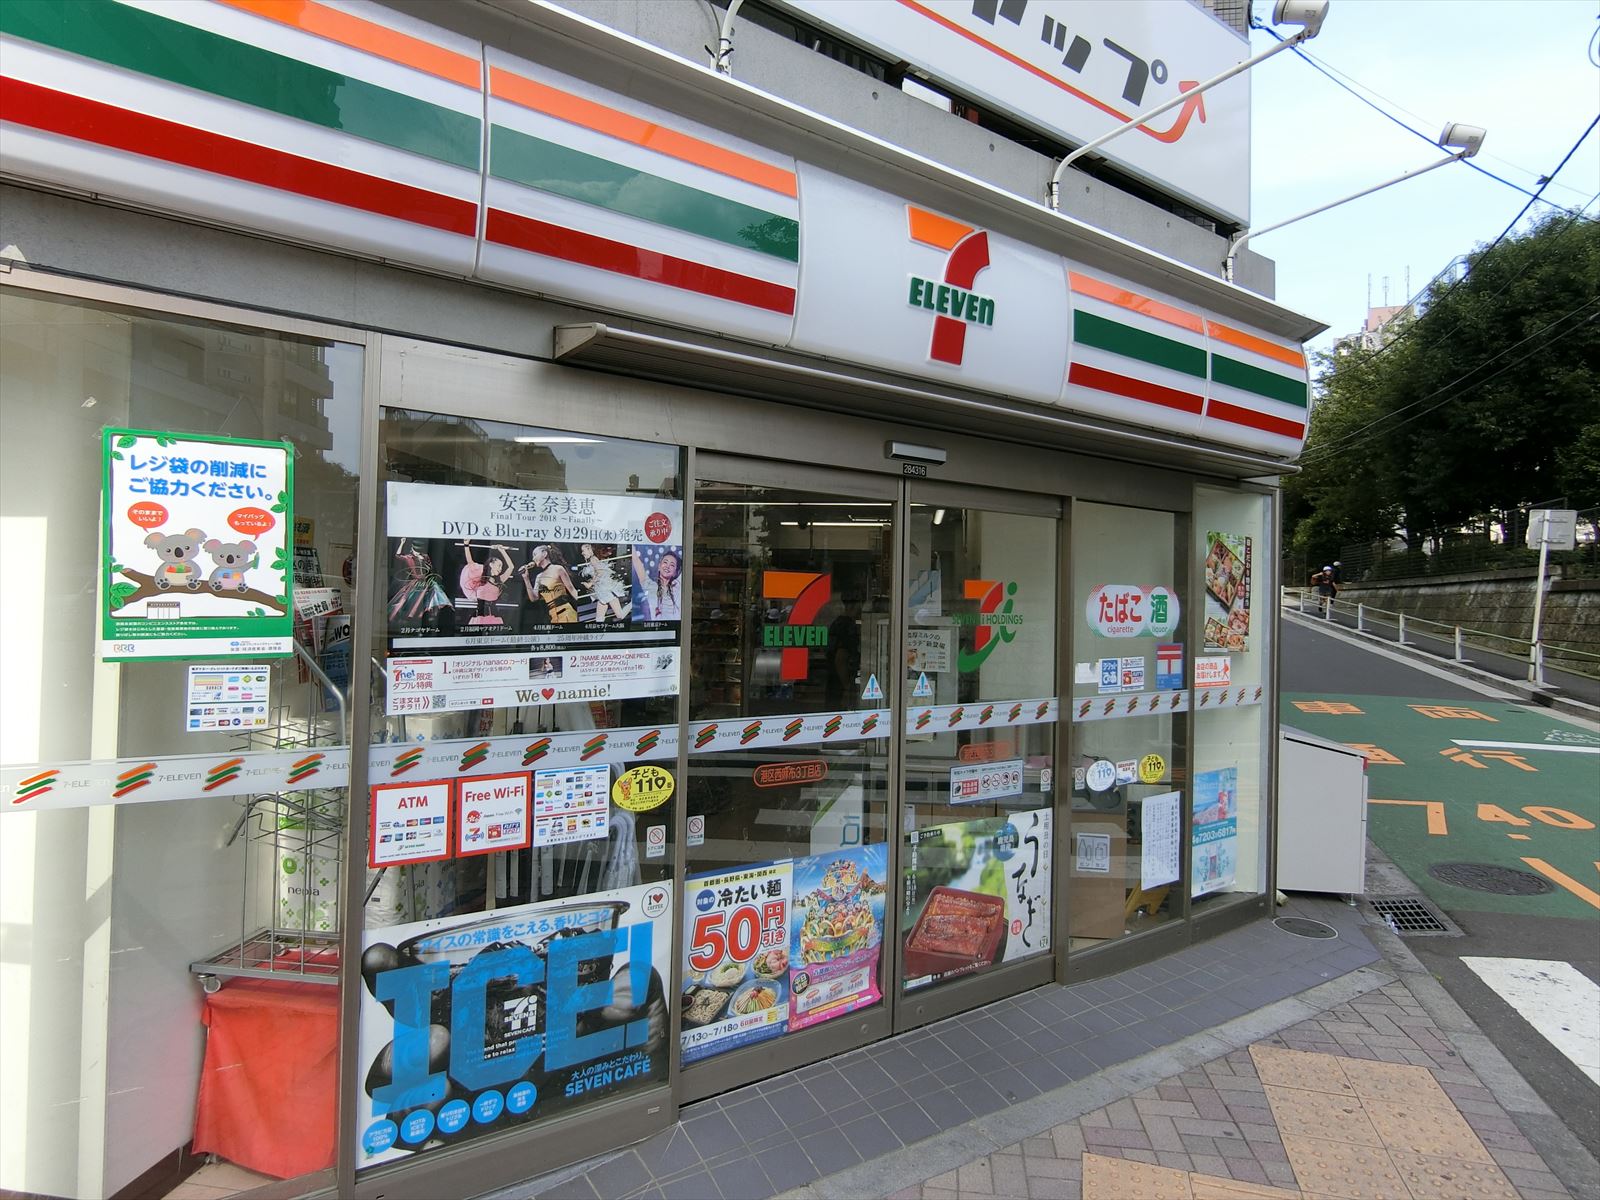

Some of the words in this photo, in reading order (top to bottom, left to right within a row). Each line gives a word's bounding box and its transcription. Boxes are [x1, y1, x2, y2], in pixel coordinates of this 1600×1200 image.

[130, 454, 267, 479] レジ袋の削減に
[903, 464, 926, 476] 284316
[129, 477, 273, 501] ご協力ください。
[498, 493, 537, 513] 安室
[541, 495, 596, 515] 奈美恵
[490, 512, 513, 520] Final
[516, 513, 537, 521] Tour
[539, 514, 557, 522] 2018
[442, 521, 479, 536] DVD
[482, 527, 492, 537] &
[496, 523, 549, 540] Blu-ray
[1099, 592, 1142, 624] たばこ
[1150, 593, 1169, 624] 酒
[1106, 625, 1134, 635] cigarette
[392, 696, 421, 705] ご注文は
[516, 689, 540, 703] We
[557, 684, 612, 700] namie!
[631, 767, 660, 780] 子ども
[397, 795, 429, 810] ATM
[465, 791, 491, 803] Free
[493, 785, 525, 800] Wi-Fi
[717, 879, 782, 908] 冷たい麺
[419, 908, 611, 953] アイスの常識をこえる、香りとコク
[372, 921, 654, 1117] ICE!
[565, 1070, 613, 1097] SEVEN
